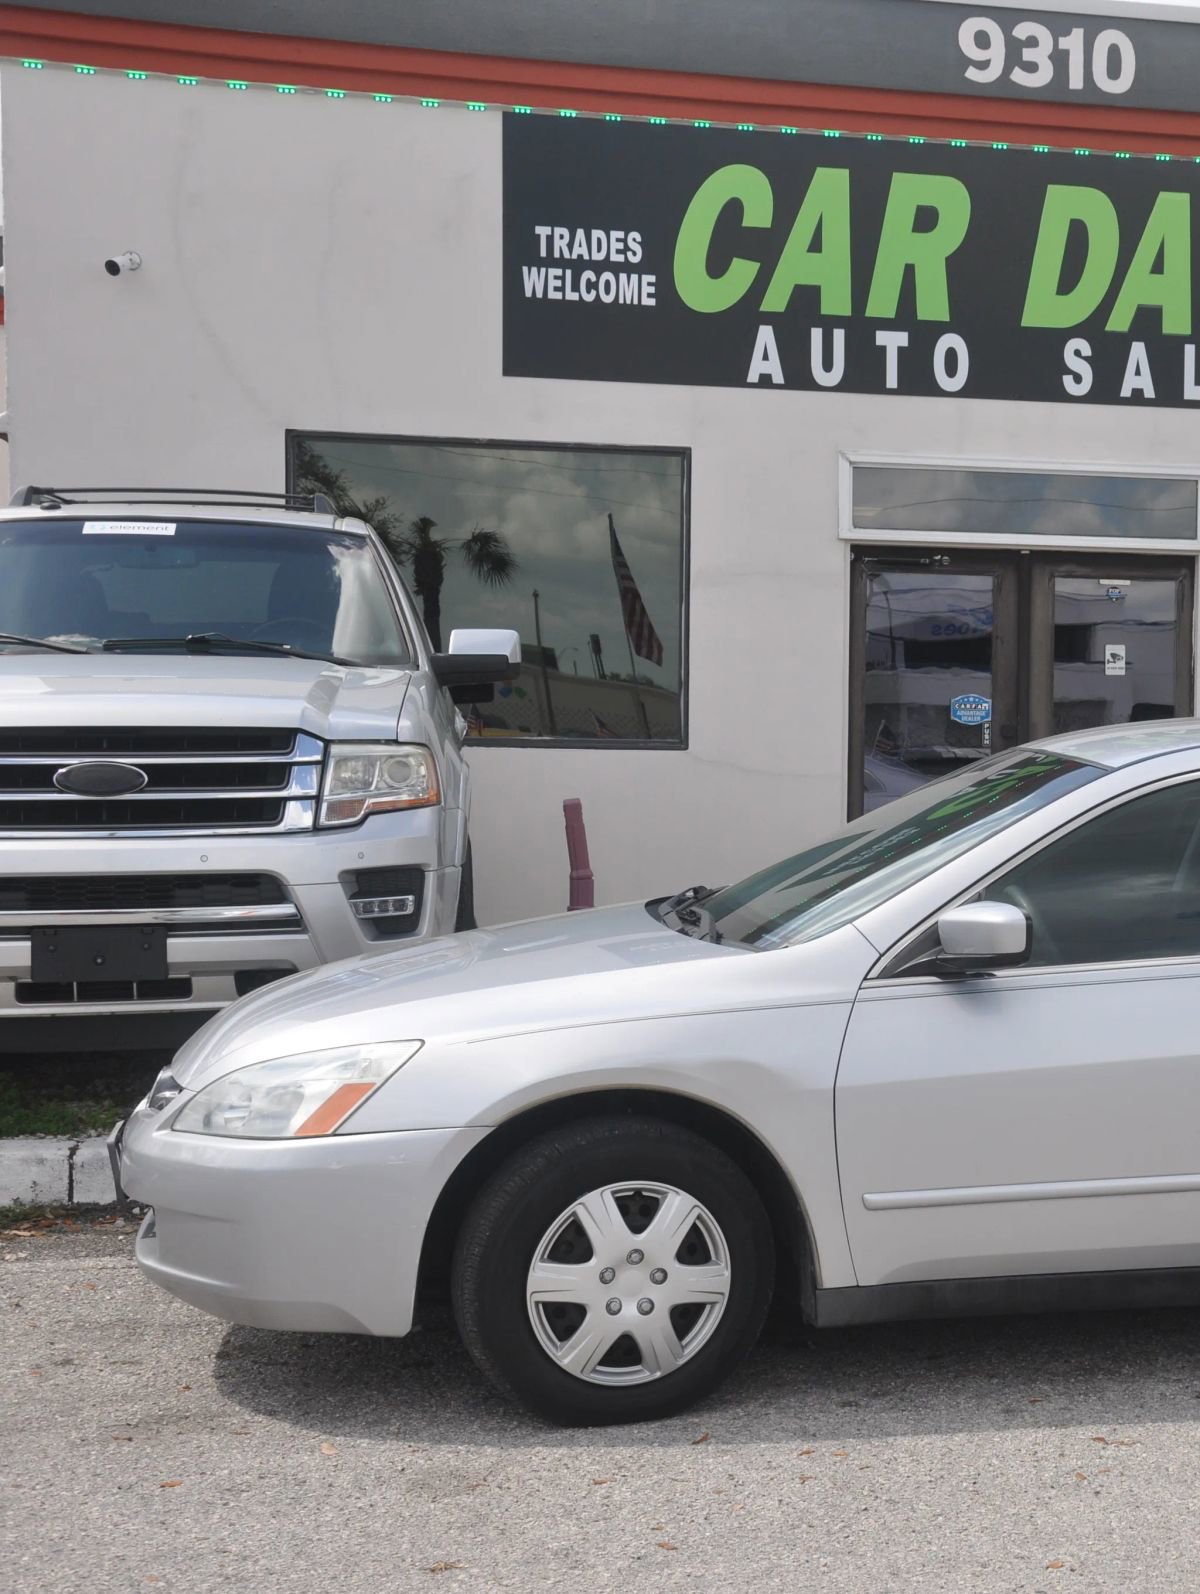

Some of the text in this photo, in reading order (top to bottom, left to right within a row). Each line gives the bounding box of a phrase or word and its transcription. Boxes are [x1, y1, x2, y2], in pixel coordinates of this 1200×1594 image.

[957, 16, 1137, 95] 9310
[534, 225, 643, 264] TRADES
[674, 165, 972, 321] CAR
[521, 265, 657, 307] WELCOME
[746, 323, 971, 394] AUTO
[109, 524, 169, 532] element
